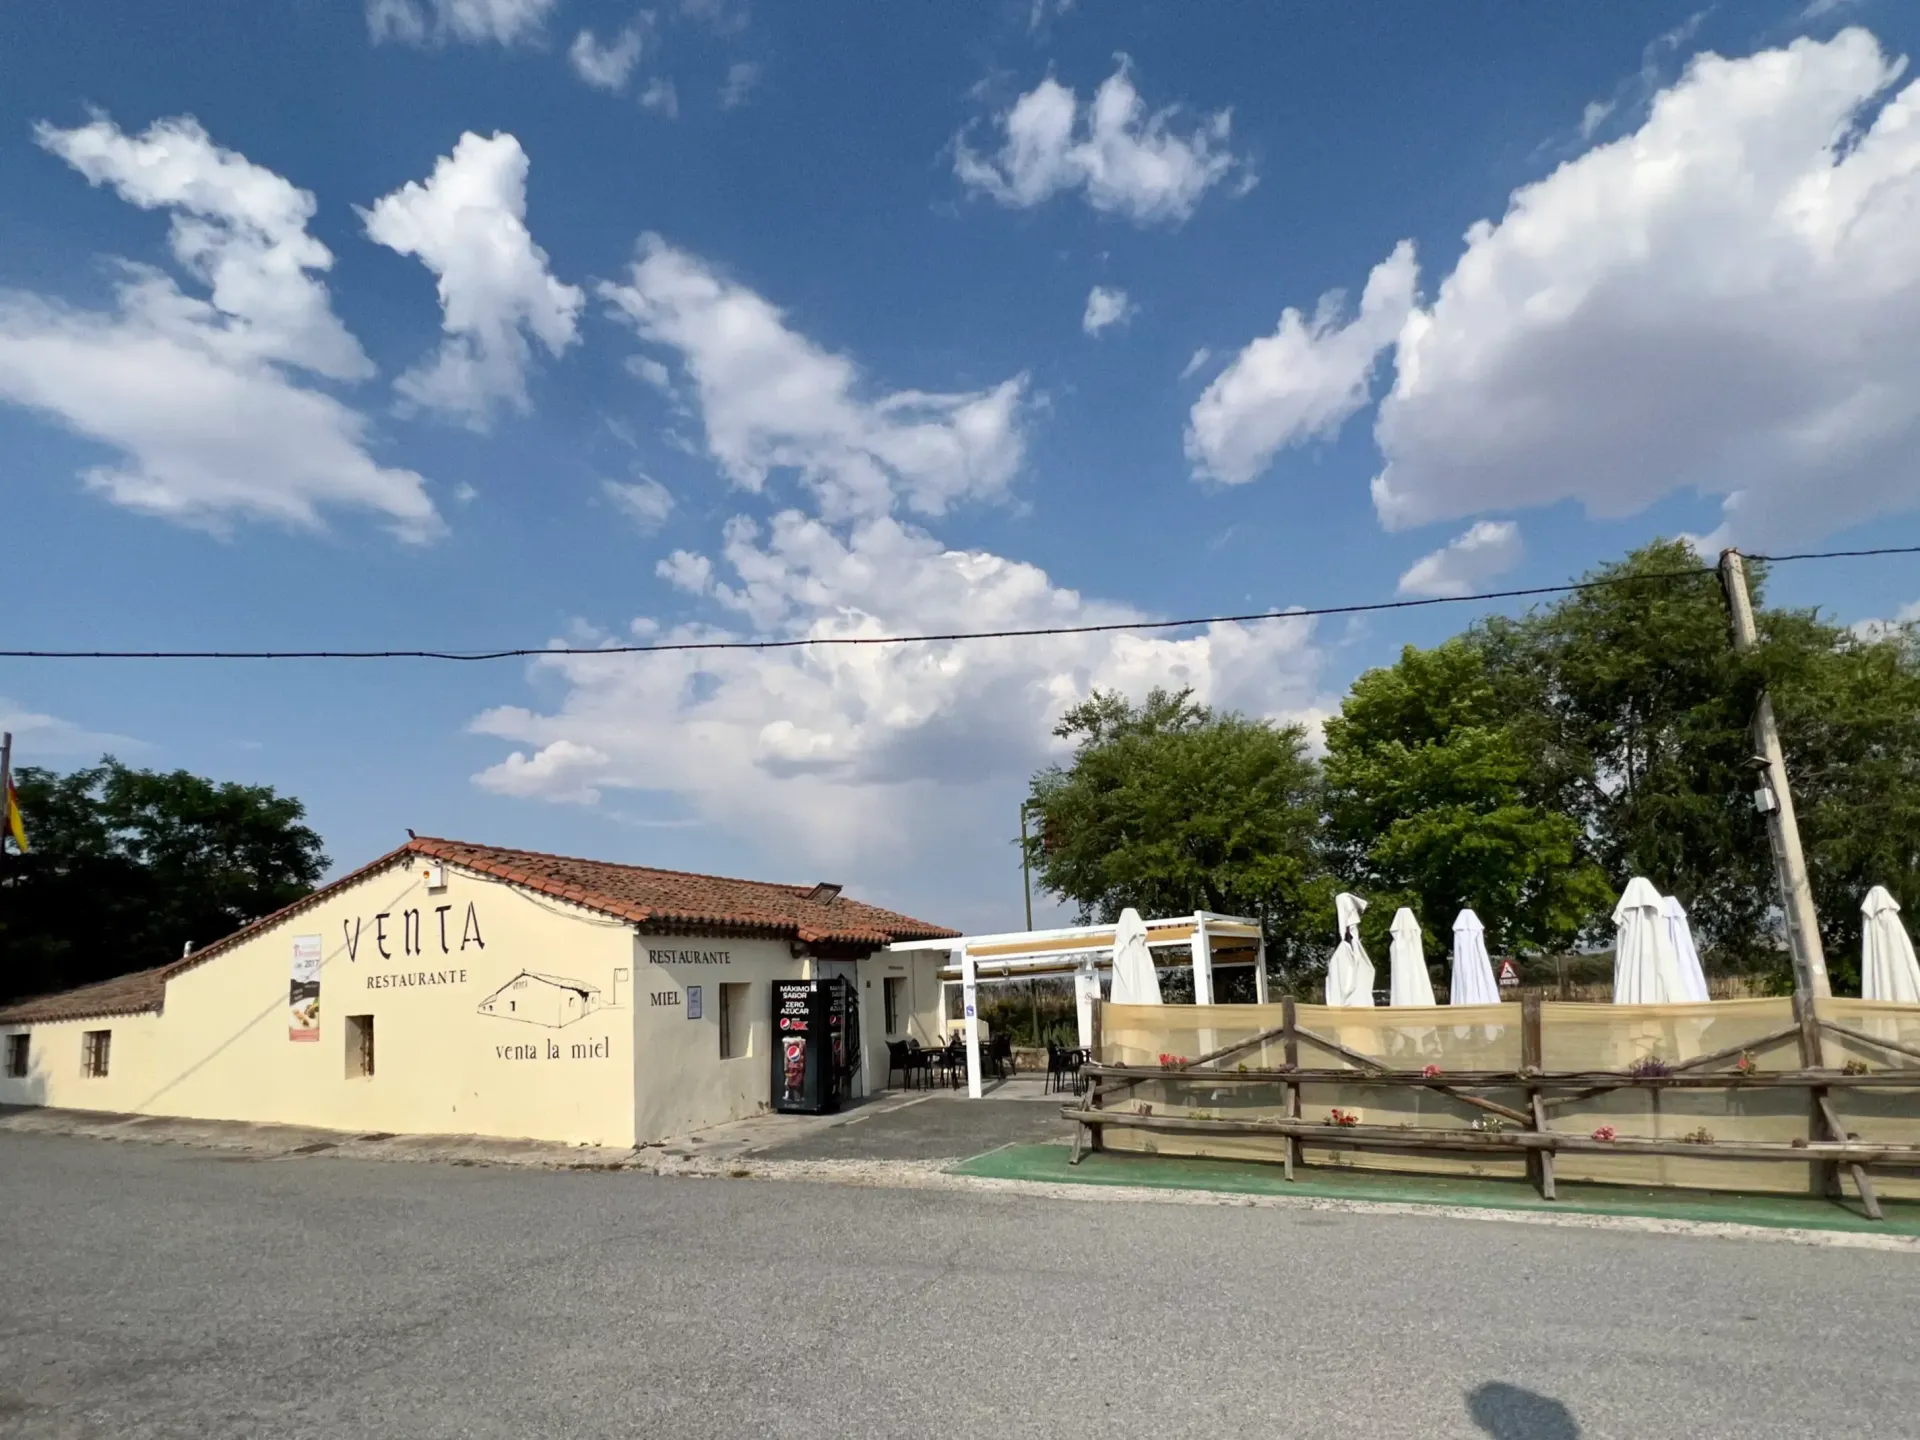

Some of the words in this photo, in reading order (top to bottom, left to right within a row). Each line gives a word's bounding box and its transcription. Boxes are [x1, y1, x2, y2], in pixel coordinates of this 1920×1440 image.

[648, 949, 732, 965] RESTAURANTE
[366, 969, 468, 990] RESTAURANTE
[779, 984, 810, 993] MÁXIMO
[649, 991, 682, 1007] MIEL
[495, 1043, 538, 1060] venta
[546, 1038, 561, 1060] la
[571, 1036, 610, 1060] miel
